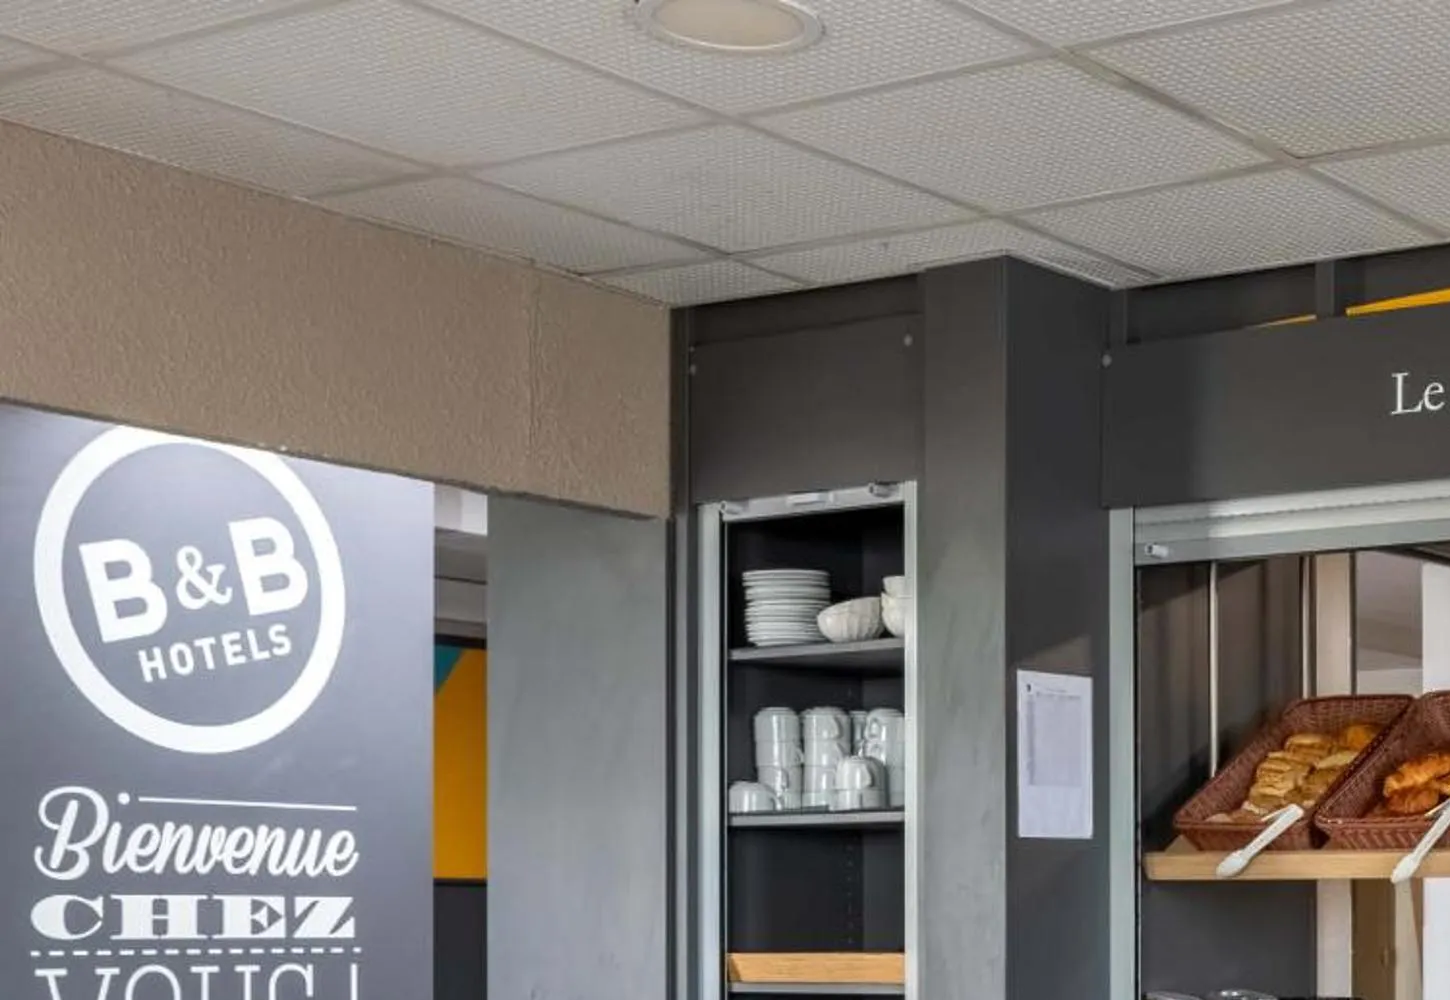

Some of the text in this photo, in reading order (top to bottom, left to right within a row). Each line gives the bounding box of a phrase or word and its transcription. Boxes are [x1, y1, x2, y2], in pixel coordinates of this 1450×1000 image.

[1391, 372, 1445, 415] Le
[79, 516, 308, 643] B&B
[138, 624, 293, 683] HOTELS
[33, 785, 360, 880] Bienvenue
[30, 893, 356, 941] CHEZ
